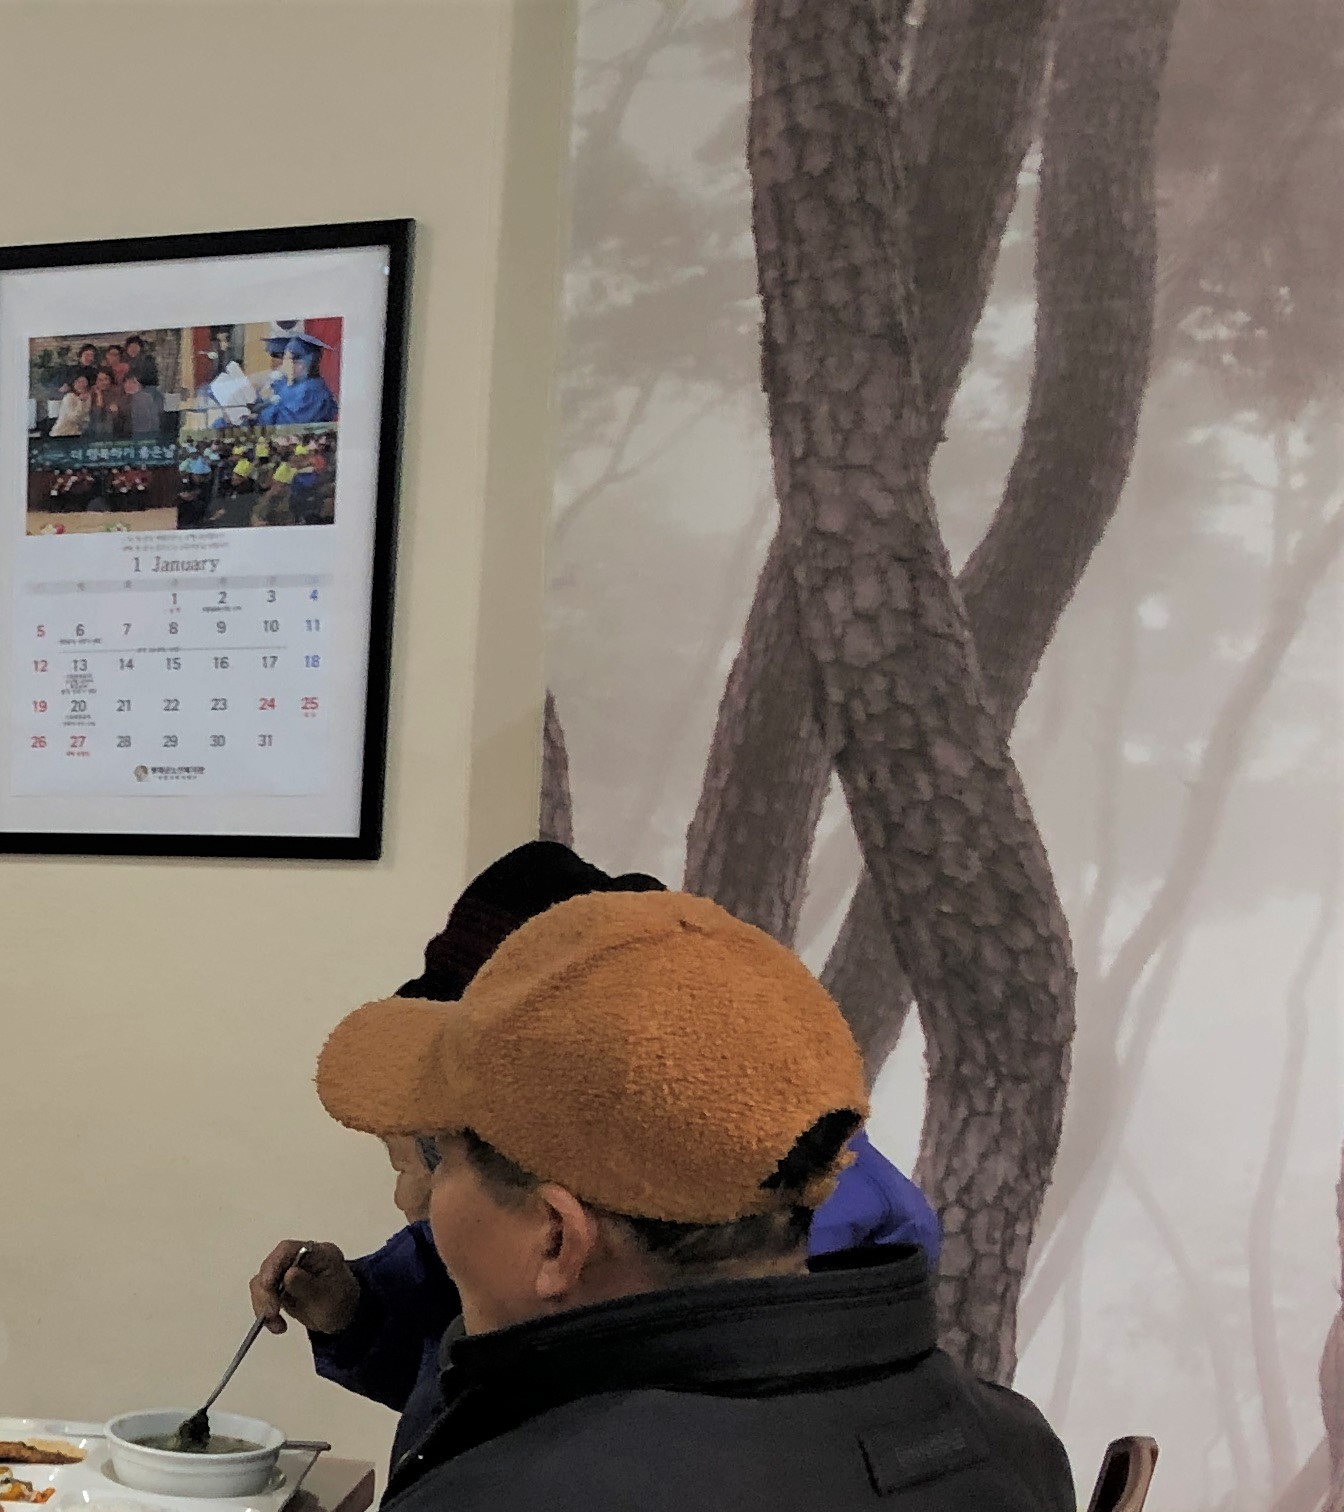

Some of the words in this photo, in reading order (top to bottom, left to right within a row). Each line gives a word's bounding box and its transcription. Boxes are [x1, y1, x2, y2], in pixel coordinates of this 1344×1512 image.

[133, 556, 141, 573] 1
[152, 556, 219, 572] January
[171, 592, 178, 605] 1
[218, 591, 227, 605] 2
[266, 589, 277, 604] 3
[309, 589, 319, 602] 4
[36, 624, 46, 638] 5
[75, 623, 85, 637] 6
[123, 622, 132, 635] 7
[168, 621, 179, 635] 8
[216, 620, 227, 635] 9
[263, 619, 280, 633] 10
[305, 618, 321, 632] 11
[33, 659, 48, 673] 12
[72, 658, 88, 672] 13
[119, 658, 135, 670] 14
[165, 657, 182, 671] 15
[213, 656, 230, 670] 16
[261, 655, 278, 669] 17
[304, 654, 321, 668] 18
[33, 700, 48, 713] 19
[70, 699, 87, 713] 20
[116, 699, 131, 712] 21
[163, 698, 180, 712] 22
[210, 697, 227, 711] 23
[258, 697, 276, 711] 24
[300, 696, 319, 710] 25
[30, 735, 47, 749] 26
[69, 735, 87, 749] 27
[116, 735, 132, 749] 28
[162, 734, 179, 748] 29
[209, 734, 226, 748] 30
[257, 734, 273, 748] 31
